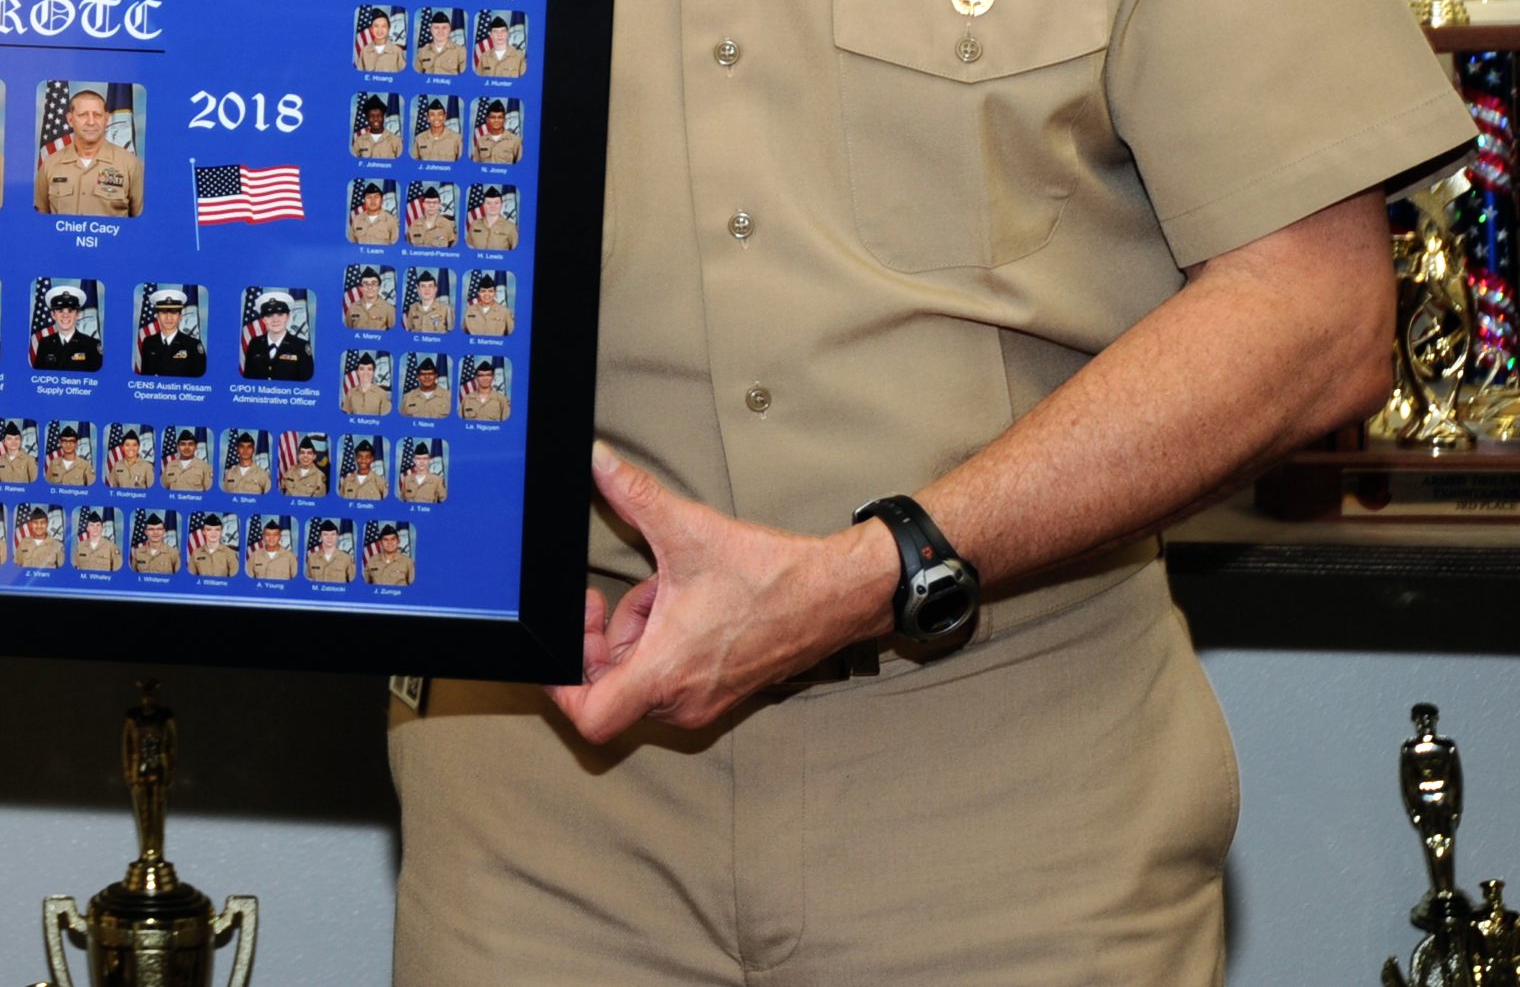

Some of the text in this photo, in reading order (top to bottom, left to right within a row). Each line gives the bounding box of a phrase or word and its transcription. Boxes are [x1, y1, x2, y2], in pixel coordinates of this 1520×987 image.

[188, 90, 304, 132] 2018
[55, 219, 119, 236] Chief Cacy
[76, 235, 97, 247] NSI
[30, 374, 59, 384] C/CPO
[60, 376, 81, 385] Sean
[36, 385, 91, 396] Supply Officer
[127, 380, 211, 392] C/ENS Austin Kissam
[229, 383, 320, 396] C/PO1 Madison Collins
[134, 390, 204, 402] Operations Officer
[232, 394, 316, 406] Administrative Officer
